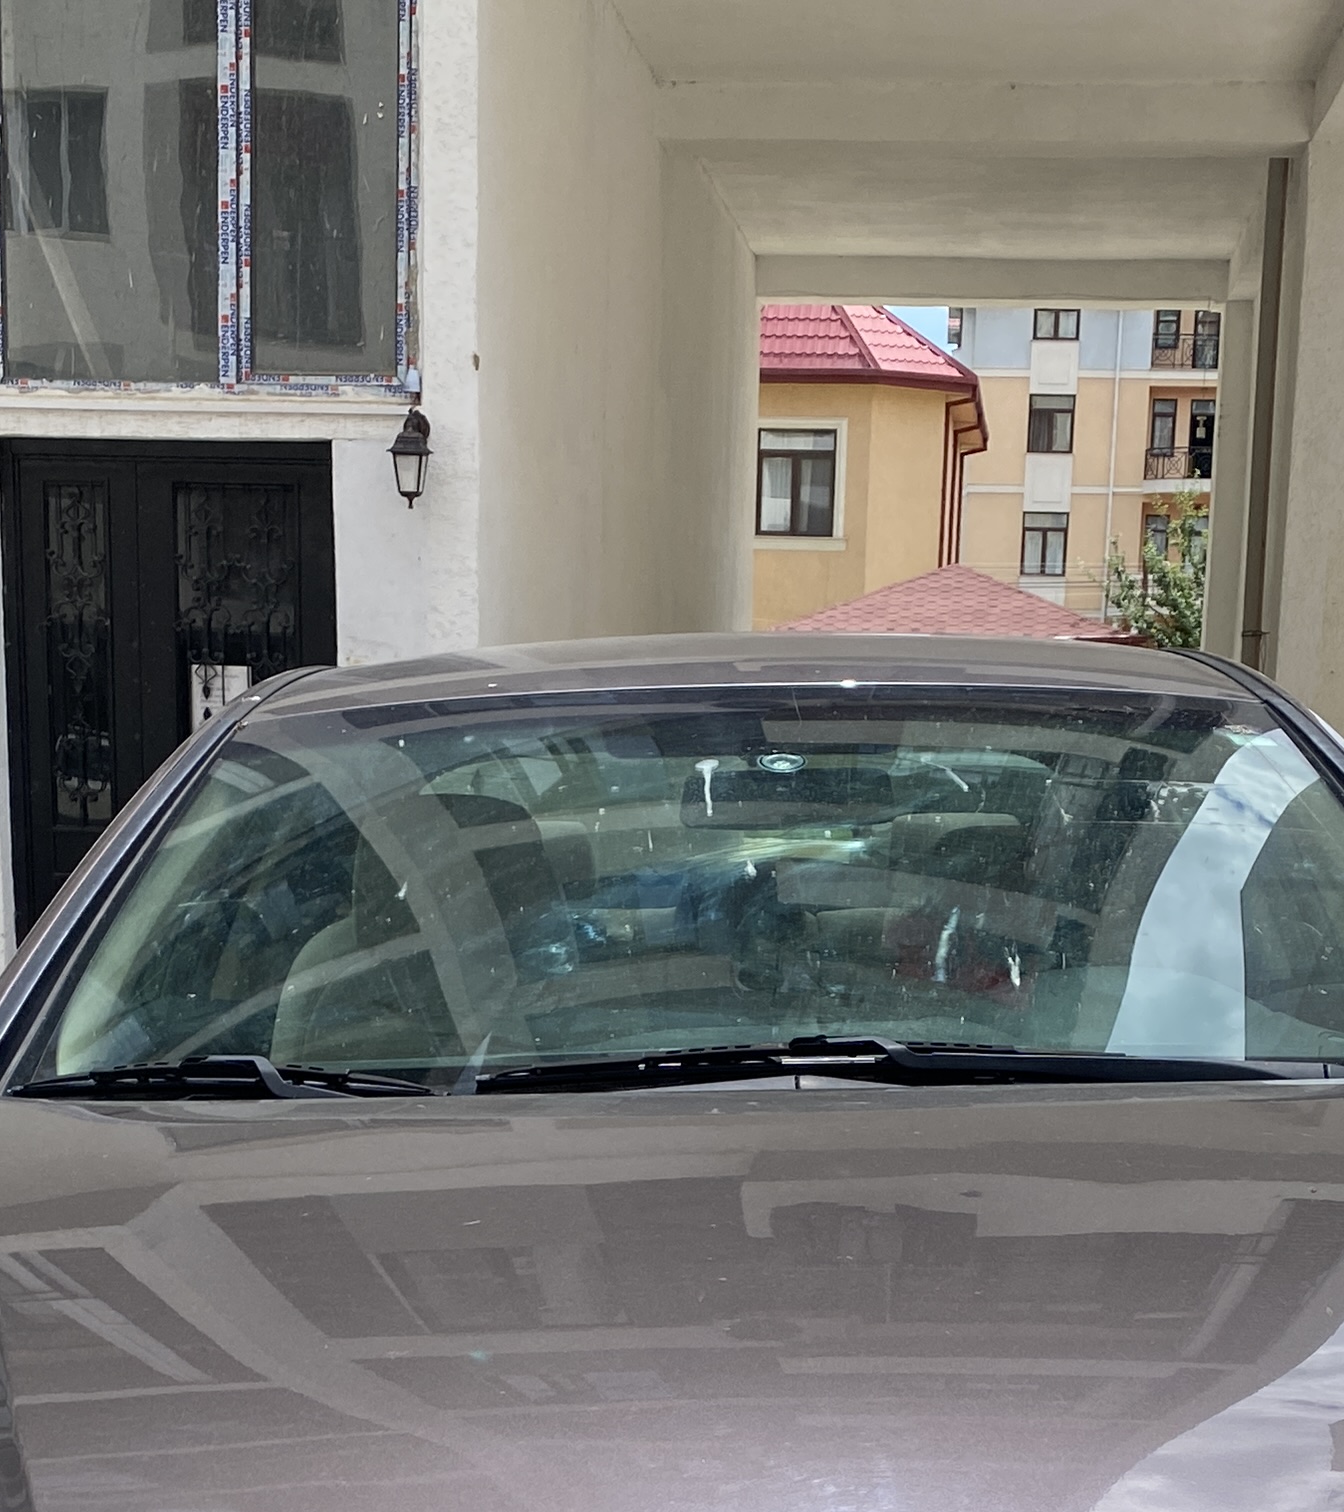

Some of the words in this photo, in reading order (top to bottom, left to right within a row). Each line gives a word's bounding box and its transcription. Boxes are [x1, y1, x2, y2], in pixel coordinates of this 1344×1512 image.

[220, 96, 229, 149] ENDERPEN
[398, 84, 406, 138] ENDERPEN
[220, 211, 230, 265] ENDERPEN
[220, 325, 230, 378] ENDERPEN
